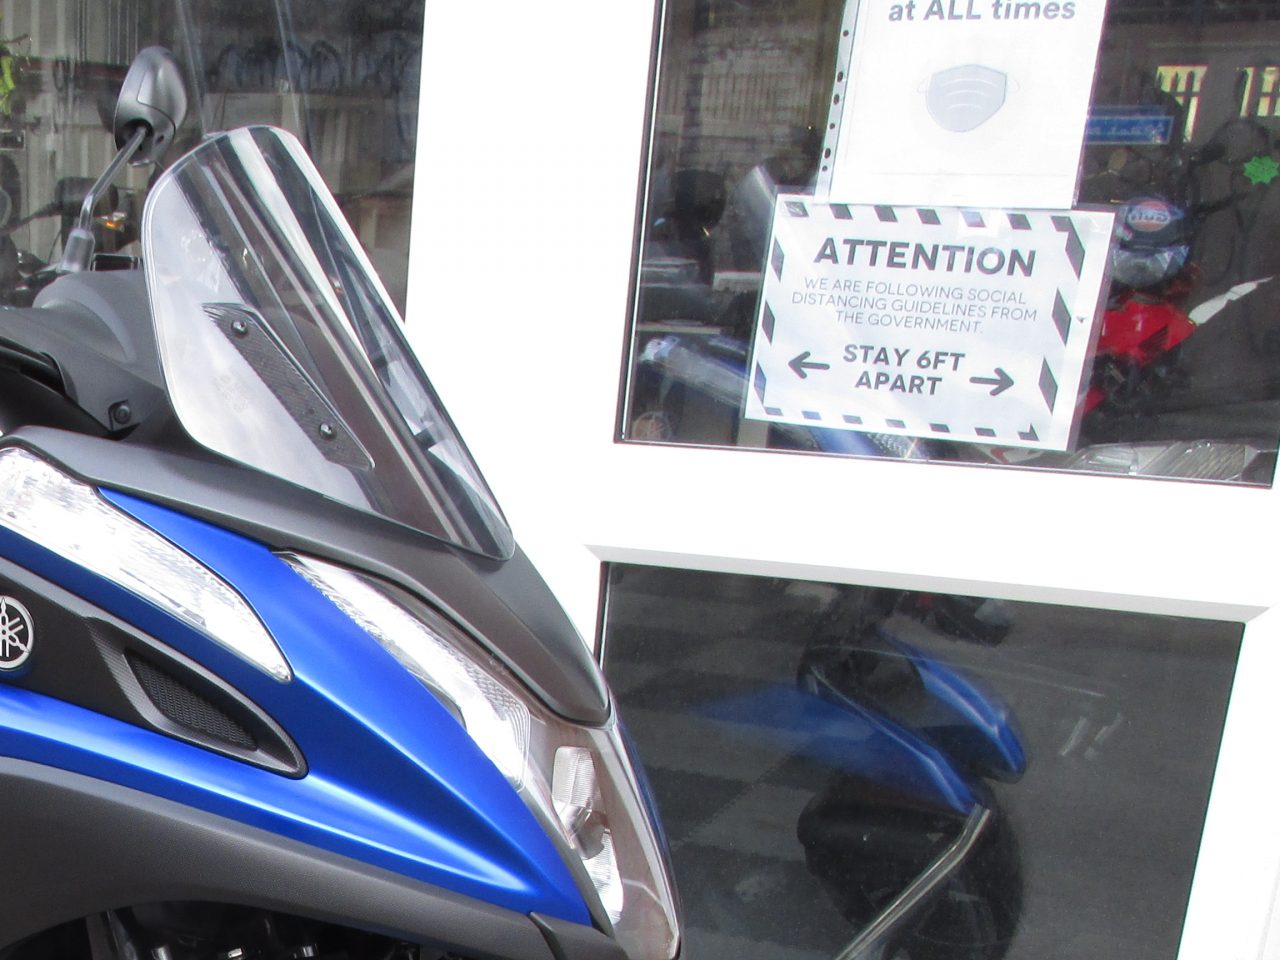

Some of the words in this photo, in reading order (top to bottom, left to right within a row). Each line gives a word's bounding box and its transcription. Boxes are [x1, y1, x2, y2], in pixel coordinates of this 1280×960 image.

[888, 0, 916, 21] at
[923, 0, 982, 20] ALL
[992, 0, 1076, 20] times
[813, 237, 1037, 278] ATTENTION
[804, 276, 829, 291] WE
[832, 278, 862, 293] ARE
[865, 281, 964, 300] FOLLOWING
[967, 288, 1027, 305] SOCIAL
[791, 292, 887, 311] DISTANCING
[891, 297, 987, 318] GUIDELINES
[990, 306, 1038, 321] FROM
[836, 310, 864, 324] THE
[868, 313, 984, 334] GOVERNMENT.
[842, 344, 910, 367] STAY
[916, 350, 966, 372] 6FT
[854, 371, 943, 396] APART
